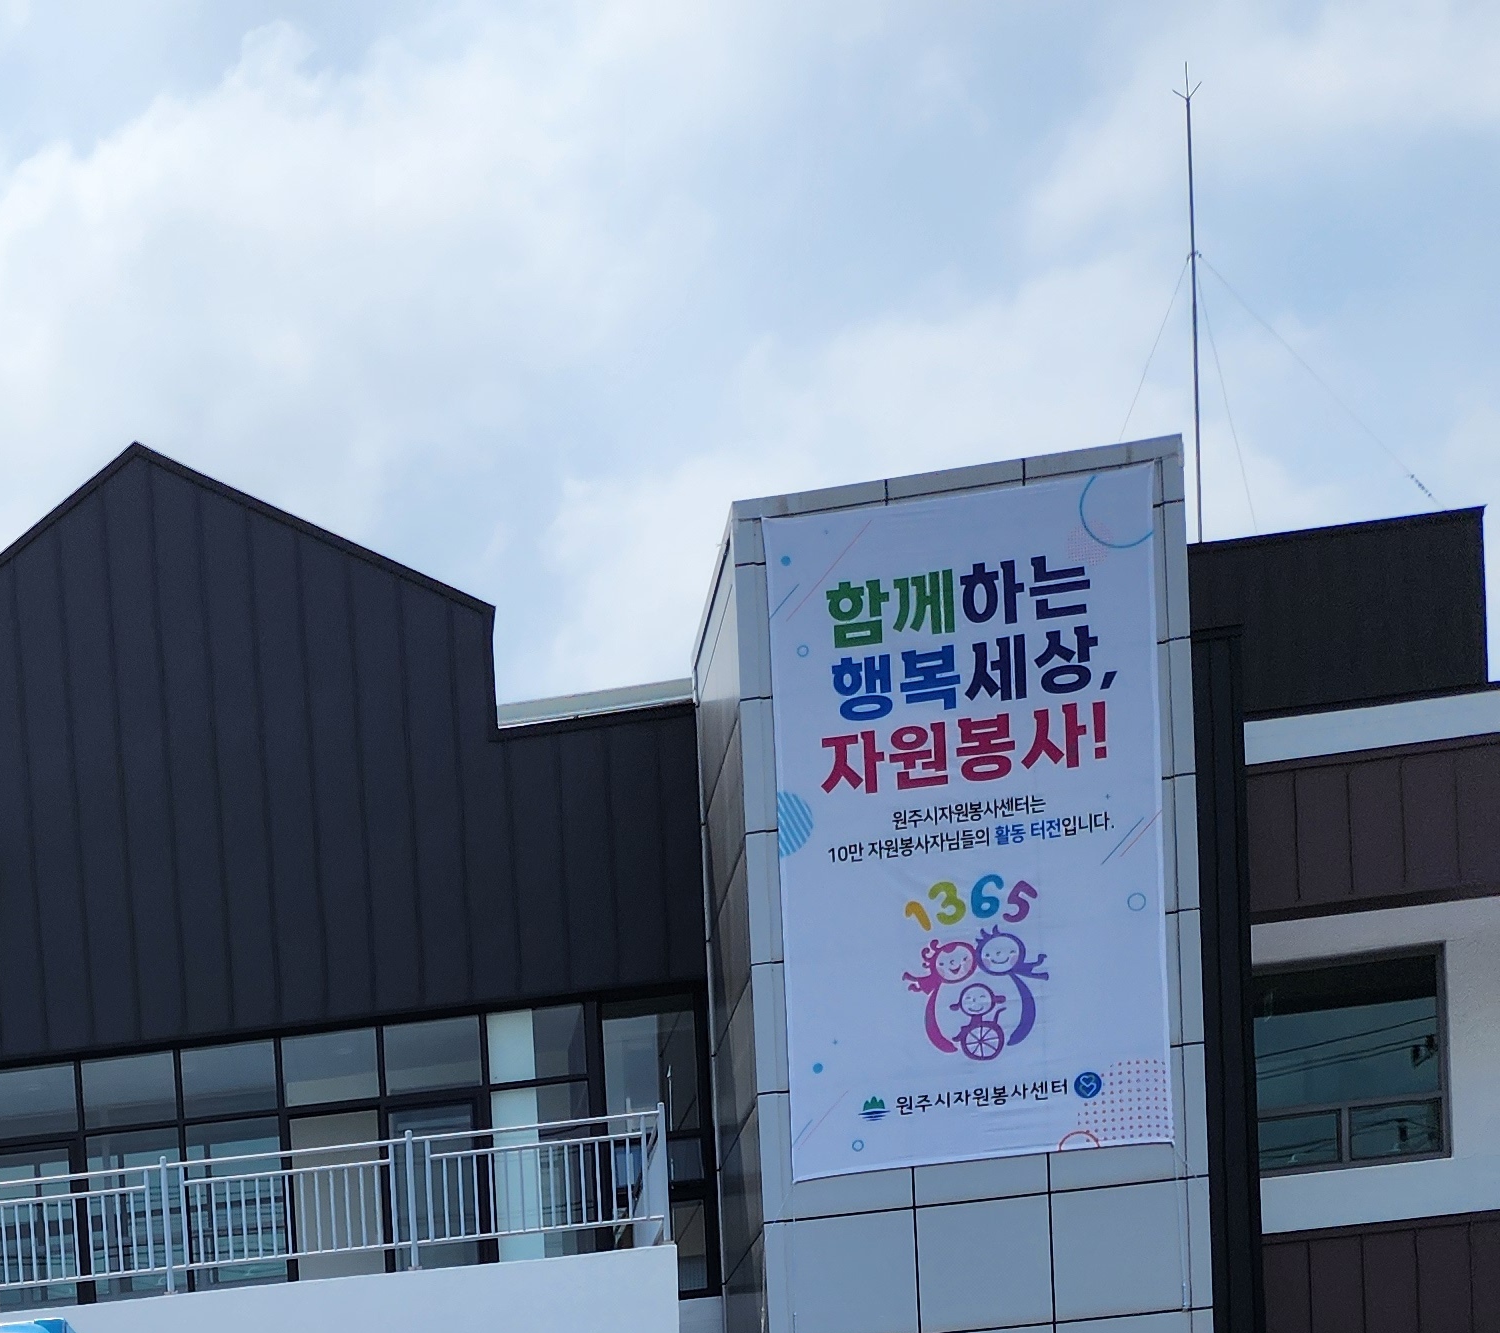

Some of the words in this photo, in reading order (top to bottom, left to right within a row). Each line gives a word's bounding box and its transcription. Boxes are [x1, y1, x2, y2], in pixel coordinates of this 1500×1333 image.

[825, 555, 1091, 649] 함께하는
[820, 700, 1108, 795] 자원봉사!
[827, 842, 864, 863] 10만
[867, 827, 990, 860] 자원봉사자님들의
[993, 823, 1026, 846] 활동
[1030, 811, 1116, 840] 터전입니다.
[891, 795, 1046, 831] 원주시자원봉사센터는
[905, 874, 1039, 932] 1365
[896, 1078, 1068, 1116] 원주시자원봉사센터
